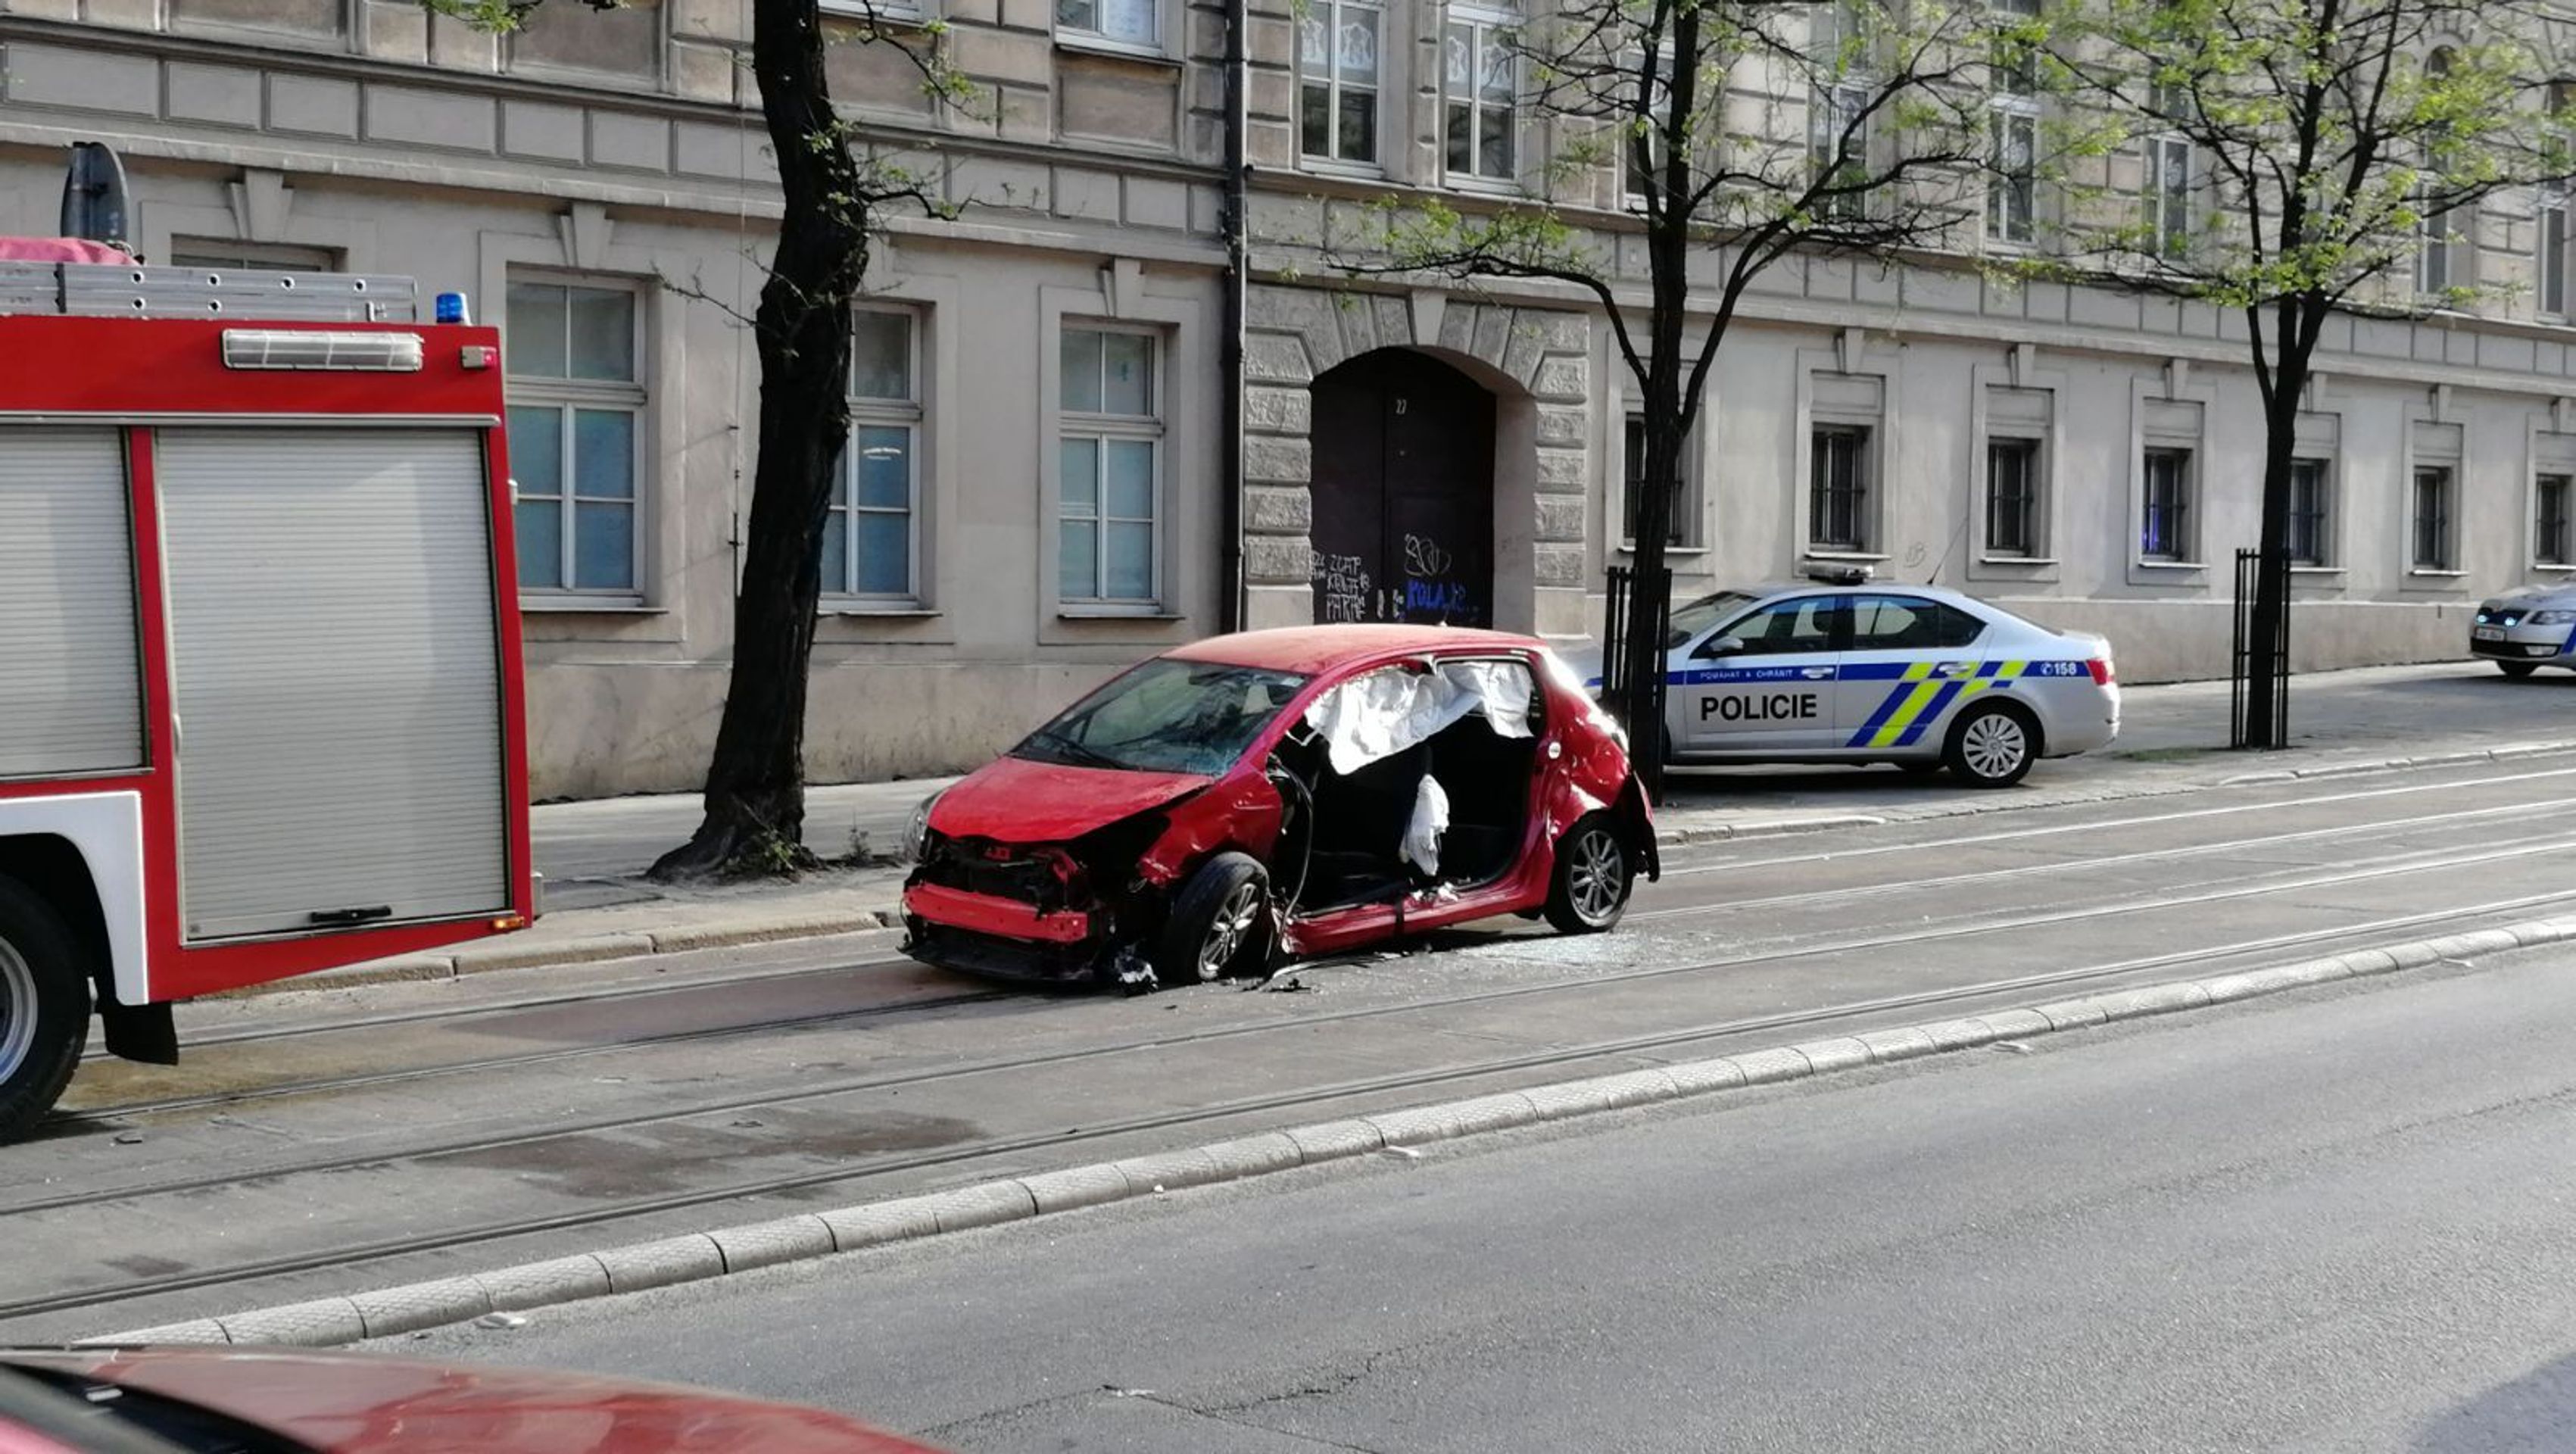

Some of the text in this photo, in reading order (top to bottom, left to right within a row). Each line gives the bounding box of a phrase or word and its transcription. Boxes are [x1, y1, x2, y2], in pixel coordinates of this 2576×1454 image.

[1396, 399, 1407, 414] 27
[2054, 662, 2077, 676] 158
[1701, 694, 1817, 721] POLICIE
